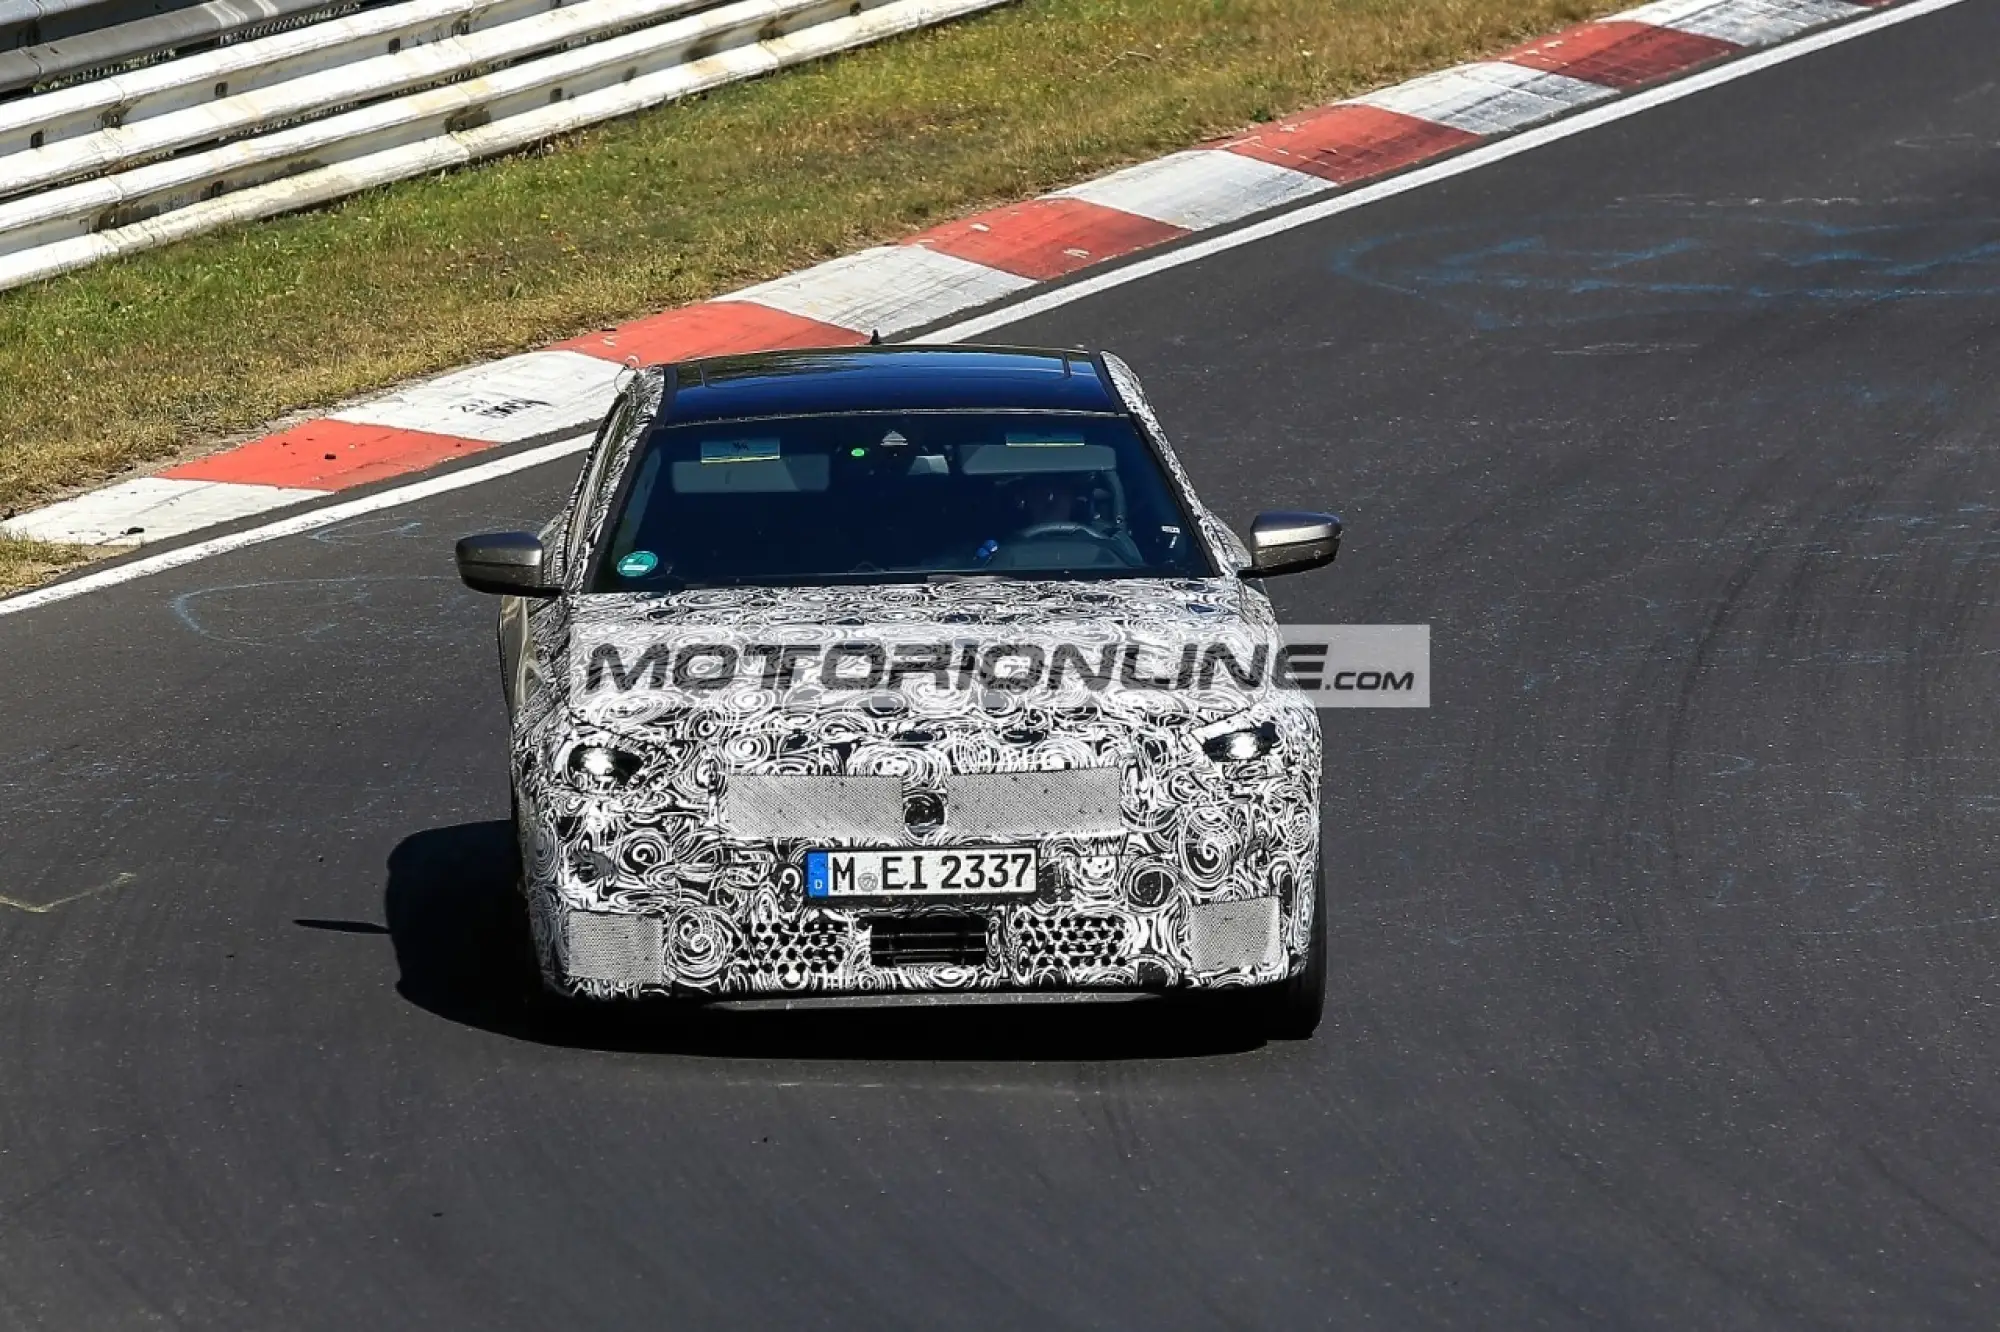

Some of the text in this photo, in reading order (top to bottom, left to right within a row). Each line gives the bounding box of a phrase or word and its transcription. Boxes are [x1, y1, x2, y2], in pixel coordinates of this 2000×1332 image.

[832, 853, 1032, 890] M EI 2337
[814, 879, 823, 890] D
